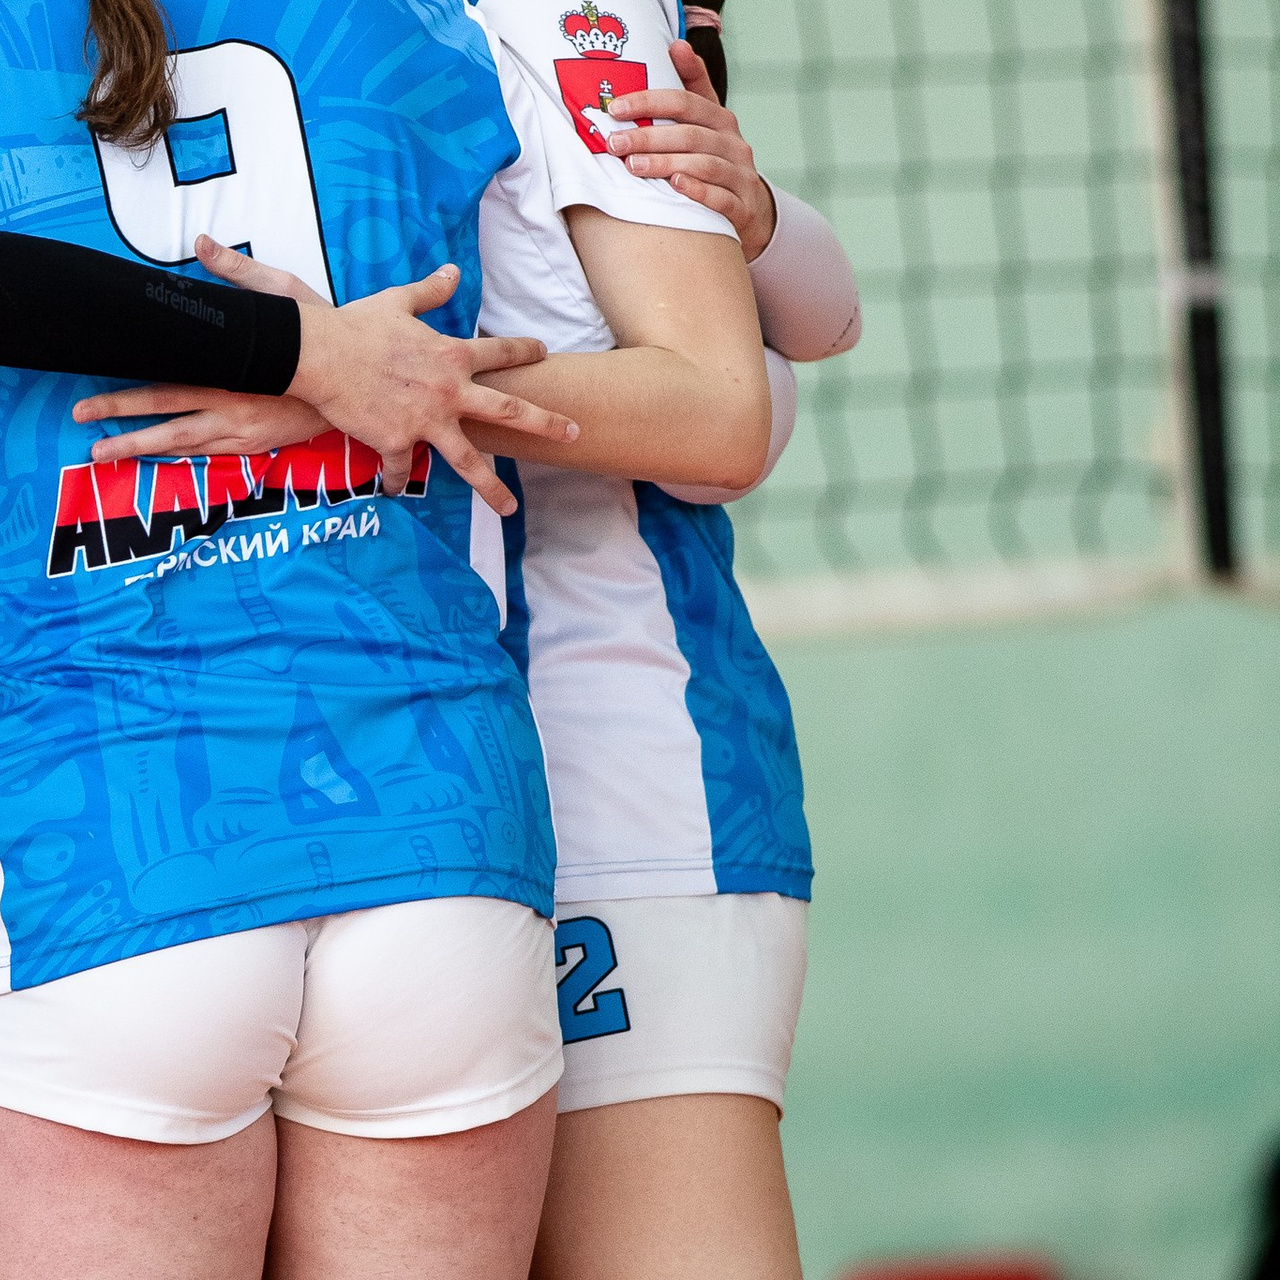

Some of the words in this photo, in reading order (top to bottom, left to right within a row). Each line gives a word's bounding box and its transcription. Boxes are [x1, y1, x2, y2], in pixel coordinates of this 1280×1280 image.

[89, 37, 339, 308] 9
[301, 505, 382, 546] КРАЙ
[554, 915, 632, 1045] 2
